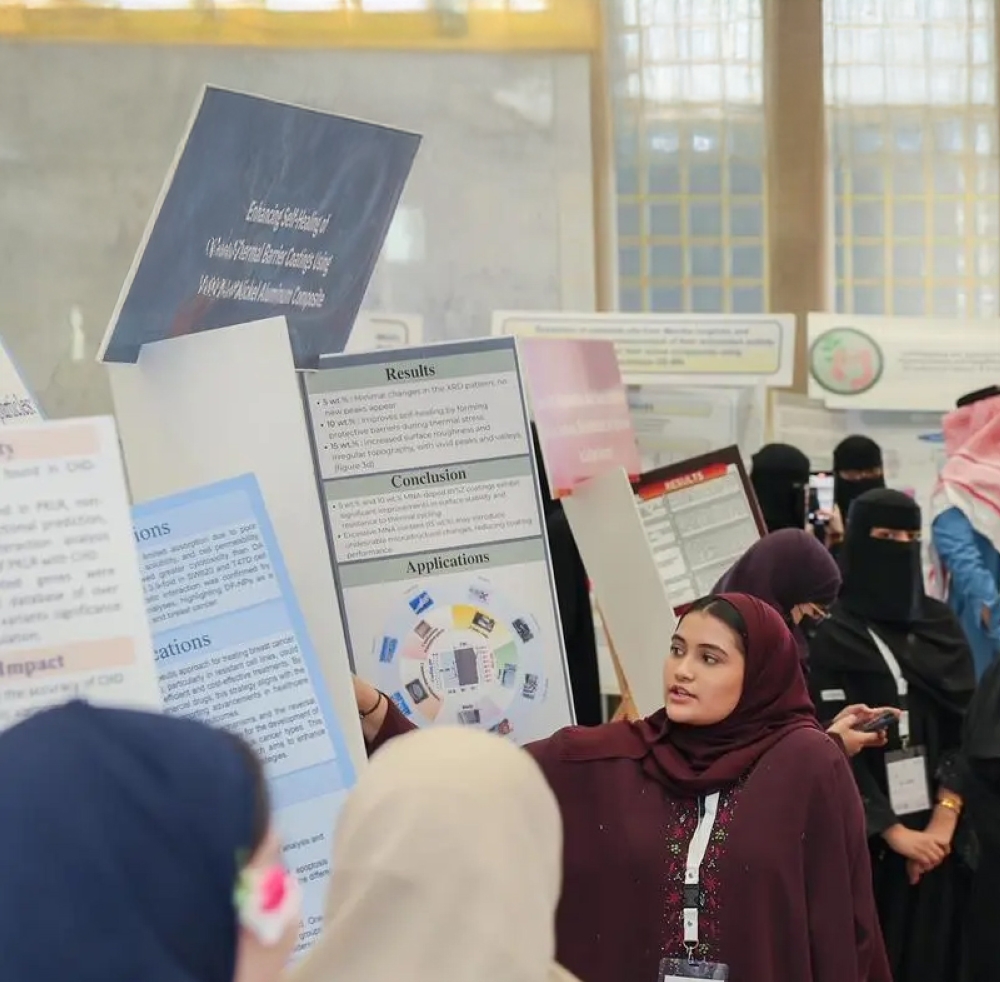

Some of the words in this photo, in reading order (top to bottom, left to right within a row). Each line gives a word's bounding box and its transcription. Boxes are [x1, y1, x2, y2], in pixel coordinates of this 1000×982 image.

[386, 364, 436, 381] Results
[391, 469, 466, 489] Conclusion
[406, 552, 490, 574] Applications
